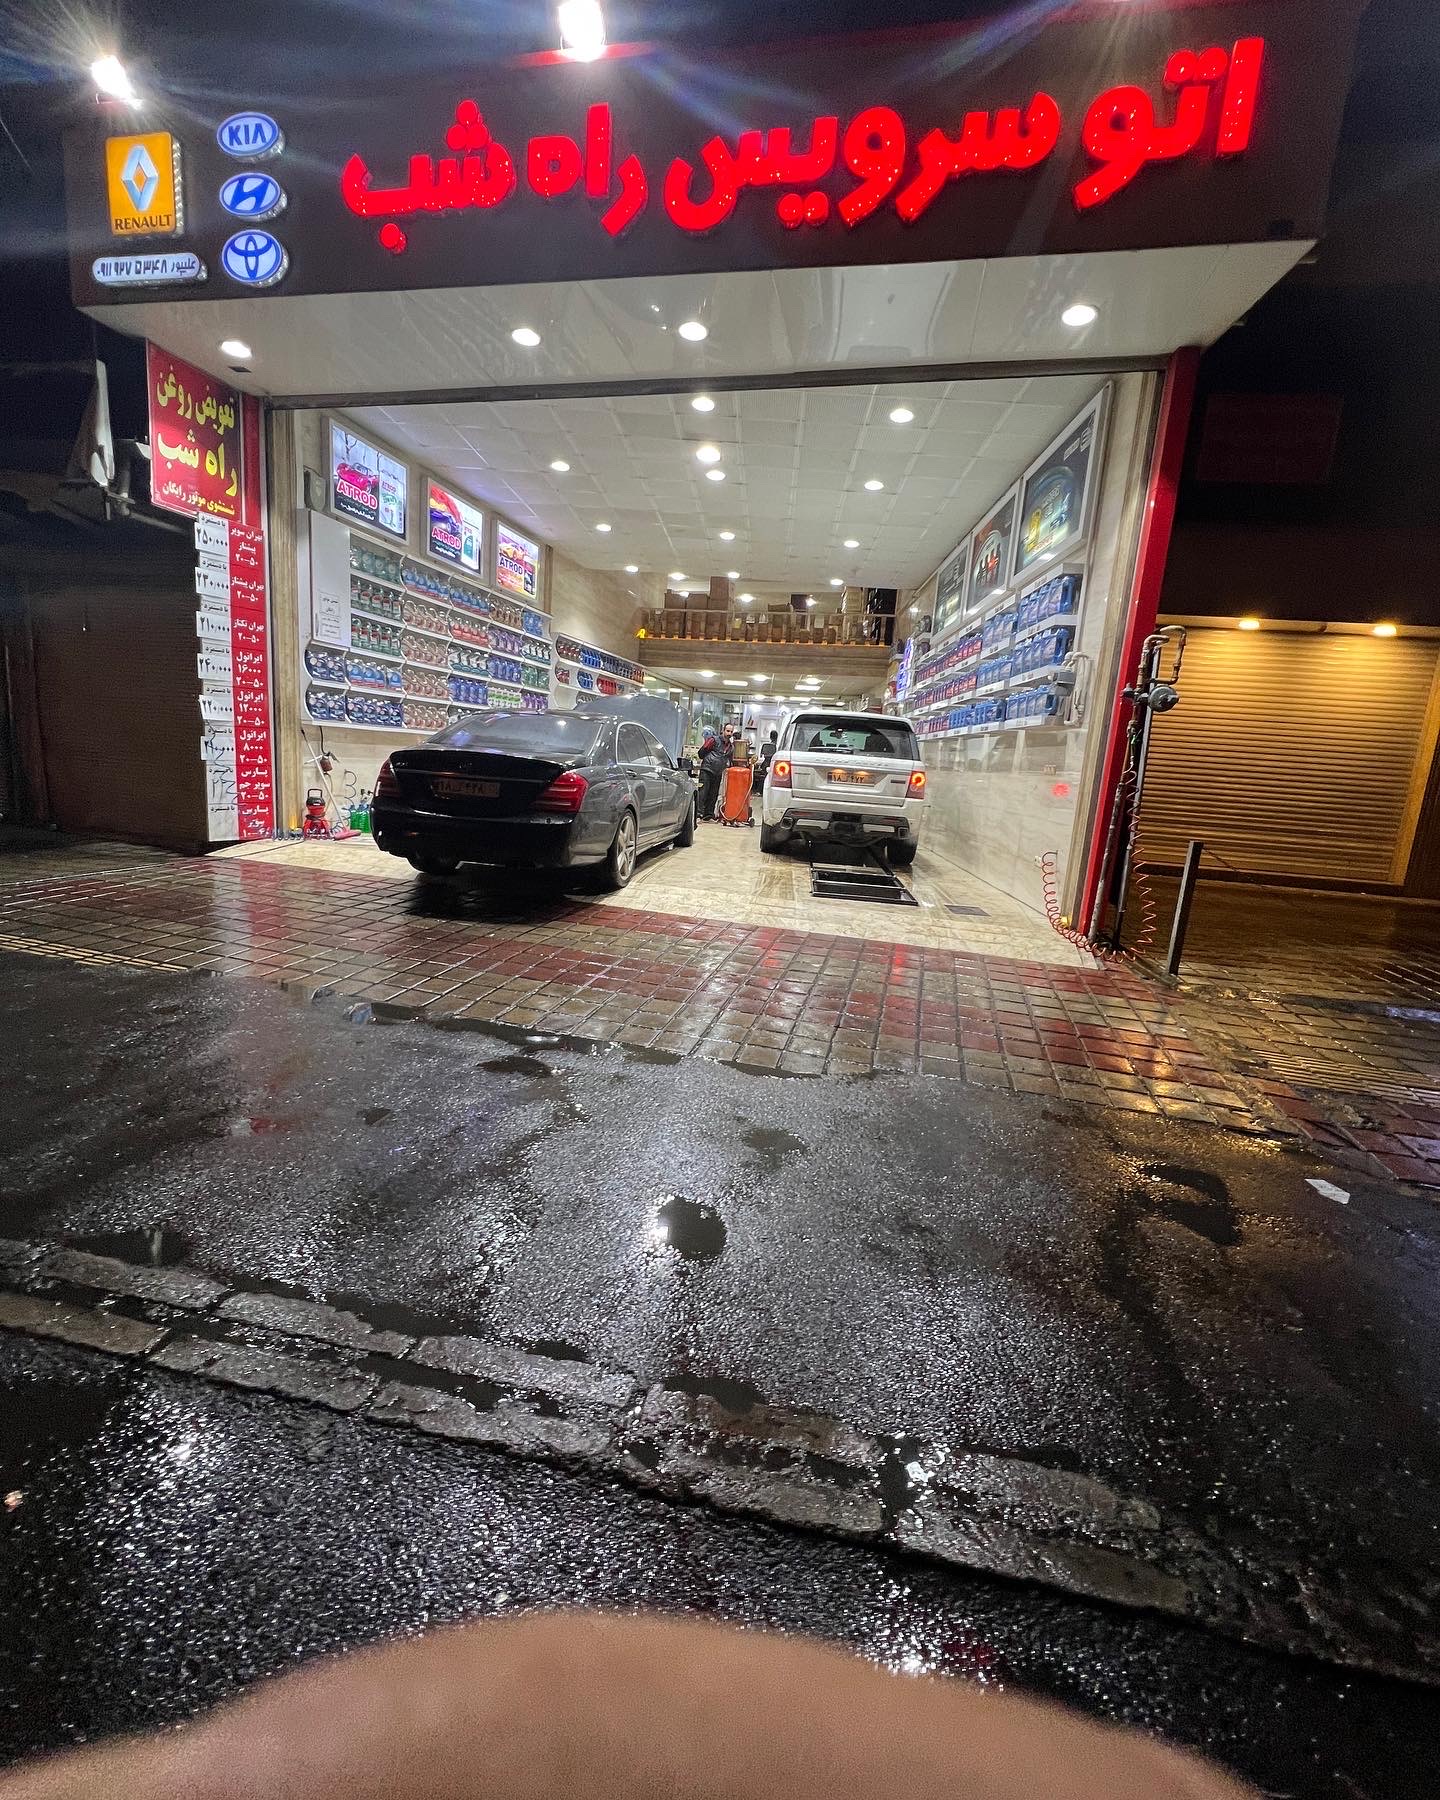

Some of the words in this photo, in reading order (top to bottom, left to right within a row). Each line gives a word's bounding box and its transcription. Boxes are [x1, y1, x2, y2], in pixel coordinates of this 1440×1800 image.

[1074, 37, 1265, 211] اتو
[228, 123, 267, 147] KIA
[526, 101, 649, 237] راه
[663, 91, 1061, 232] سرویس
[341, 99, 516, 252] شب
[114, 214, 172, 231] RENAULT
[156, 364, 192, 419] روغن
[195, 384, 235, 435] تعویض
[157, 429, 199, 469] شب
[205, 442, 237, 497] راه
[162, 481, 187, 501] رایگان
[187, 491, 206, 506] موتور
[336, 480, 378, 510] ATROD
[431, 526, 462, 550] ATROD
[499, 557, 523, 575] ATROD
[236, 651, 263, 663] ایرانول
[238, 664, 261, 673] ۱۶۰۰۰
[237, 690, 264, 703] ایرانول
[239, 703, 262, 712] ۱۲۰۰۰
[239, 730, 266, 741] ایرانول
[243, 743, 263, 751] ۸۰۰۰
[241, 767, 268, 777] پارس
[253, 781, 270, 790] سوپر
[242, 805, 269, 815] پارس
